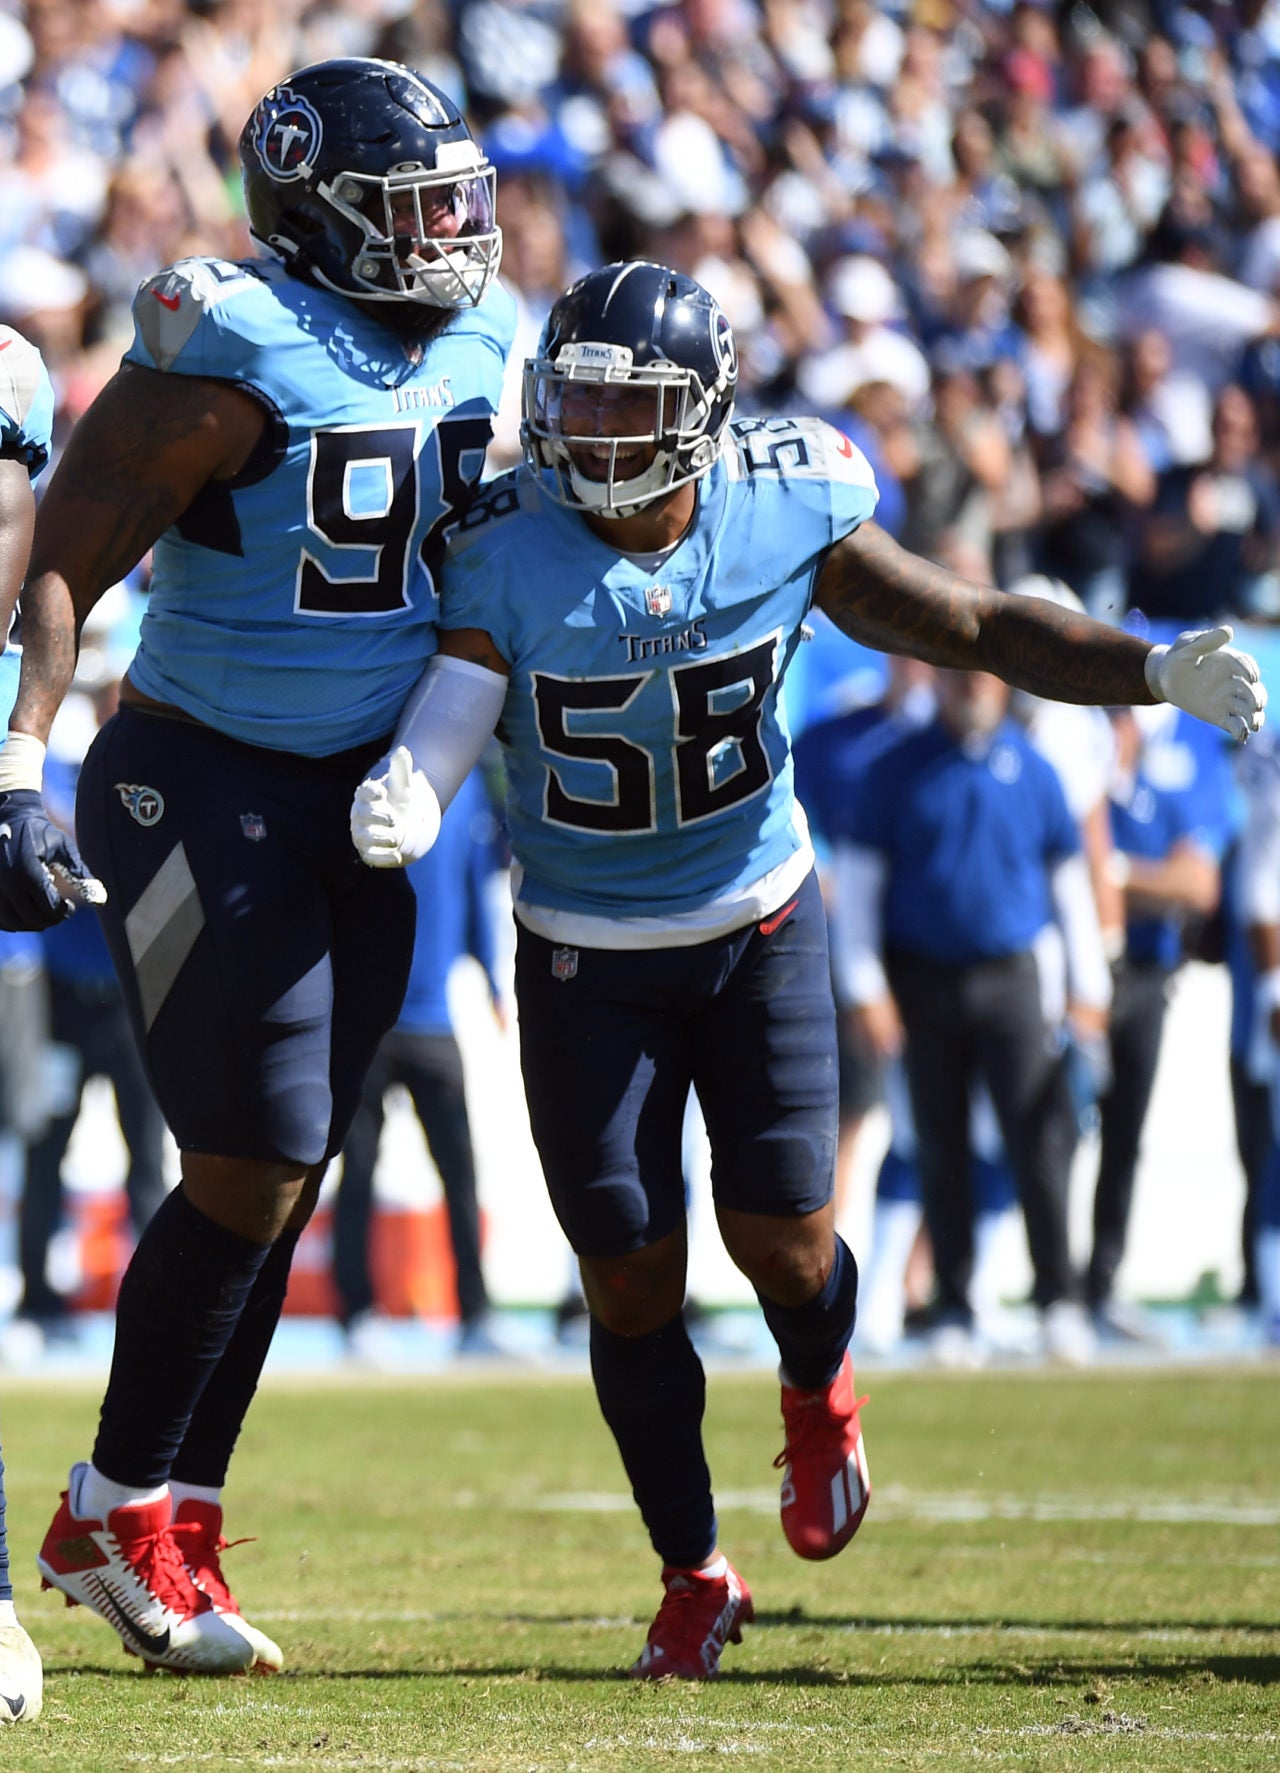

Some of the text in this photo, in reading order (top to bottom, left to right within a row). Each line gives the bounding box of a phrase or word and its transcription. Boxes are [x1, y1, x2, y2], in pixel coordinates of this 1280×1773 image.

[581, 345, 613, 360] TITANS
[384, 376, 455, 414] TITANS
[460, 470, 520, 532] 8
[618, 618, 707, 663] TITANS
[528, 624, 784, 835] 58
